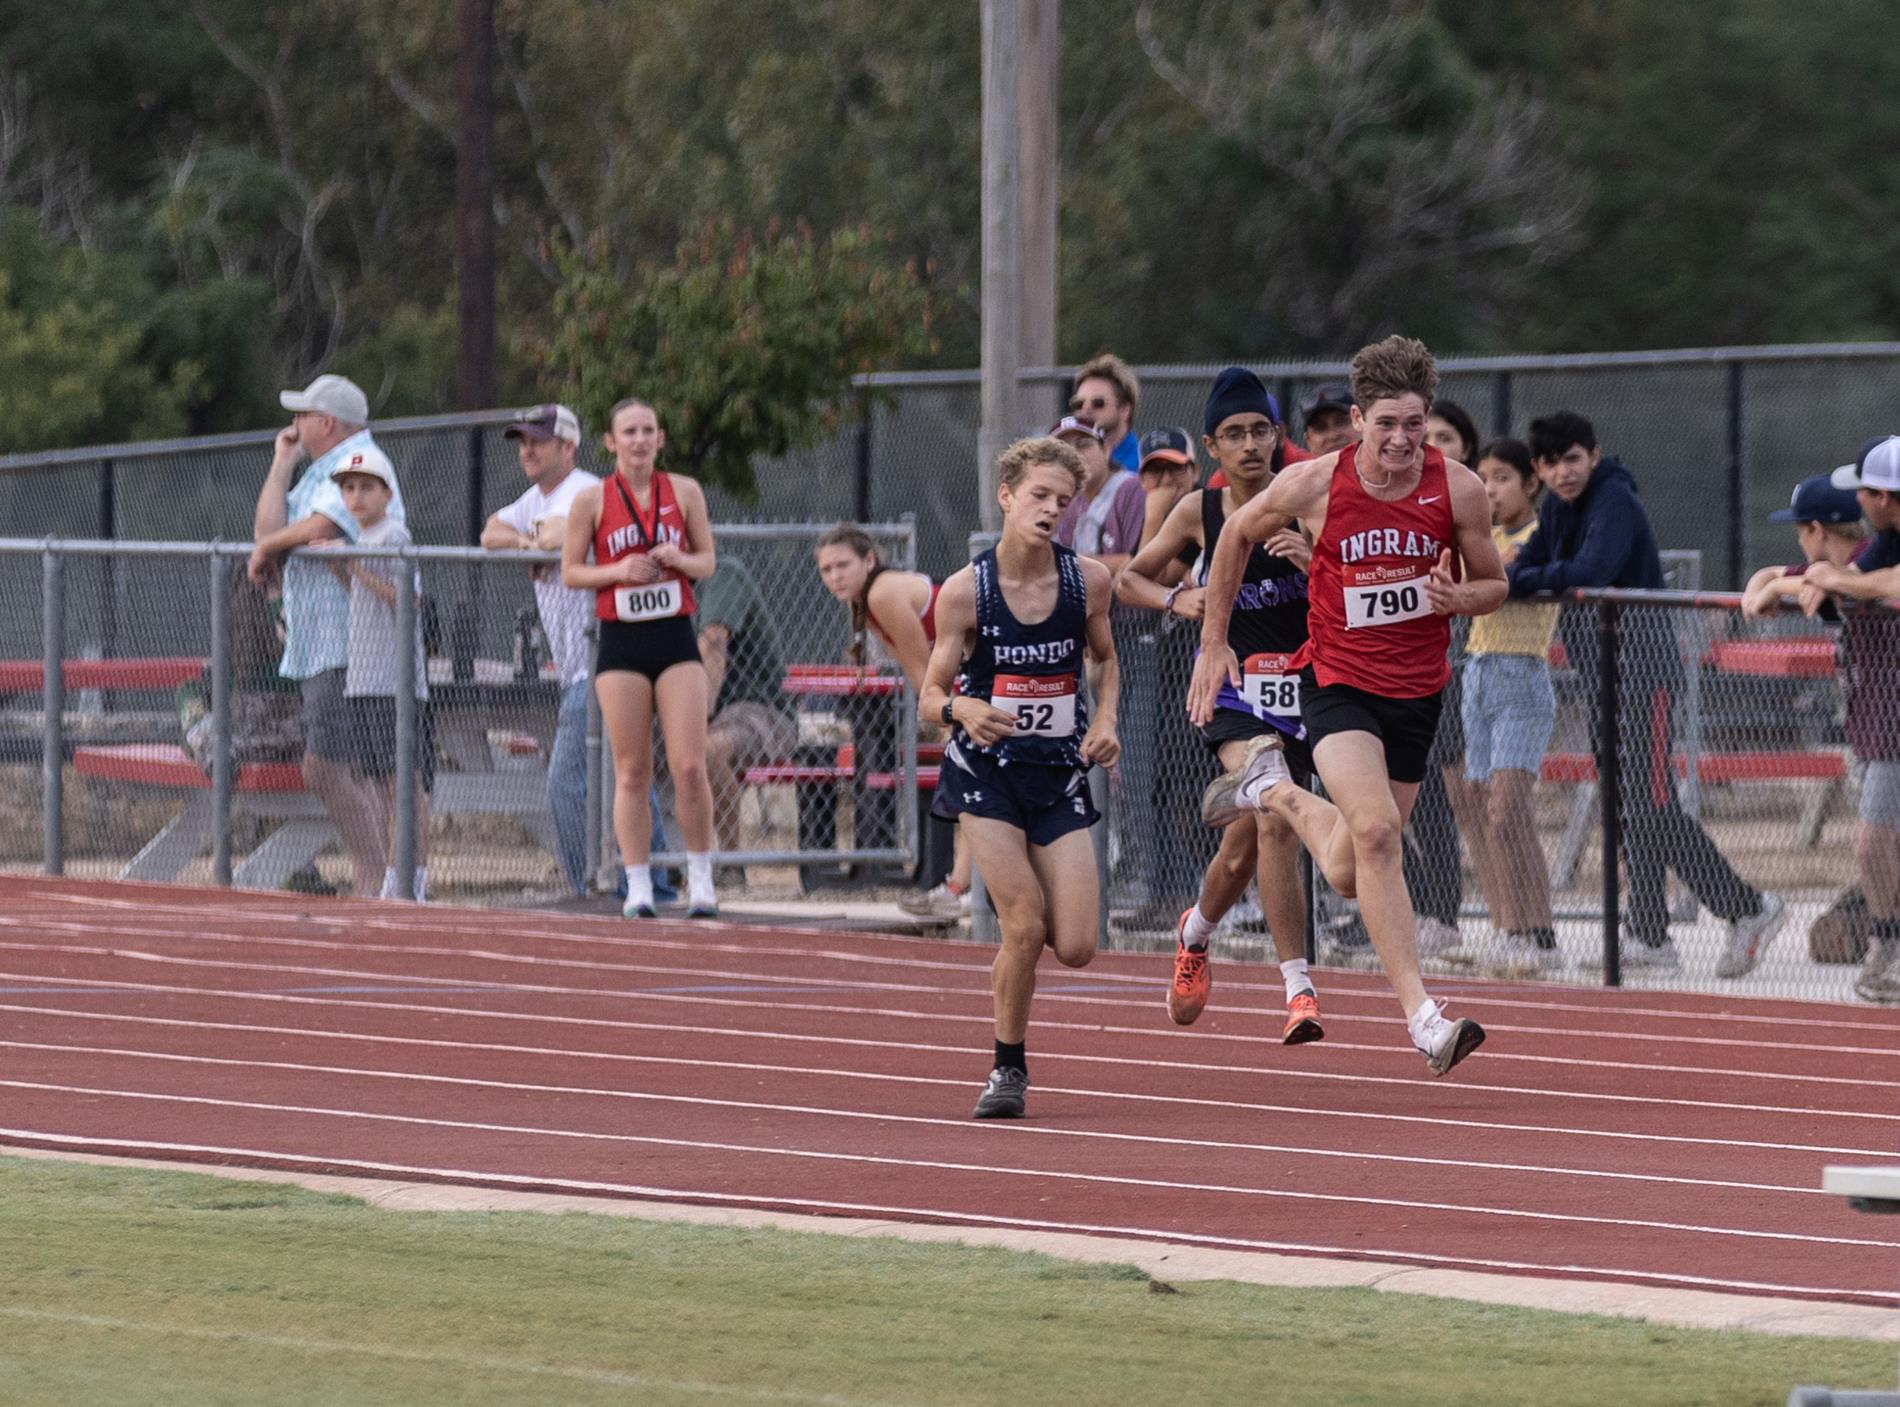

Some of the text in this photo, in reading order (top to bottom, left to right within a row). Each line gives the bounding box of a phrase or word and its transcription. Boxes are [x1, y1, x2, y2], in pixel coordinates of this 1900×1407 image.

[607, 523, 681, 558] INGAM
[1340, 528, 1440, 564] INGRAM
[1355, 572, 1377, 581] RACE
[1387, 565, 1416, 578] RESULT
[629, 589, 671, 613] 800
[1360, 586, 1419, 619] 790
[993, 638, 1074, 666] HONDO
[1258, 660, 1279, 669] RACE
[1006, 681, 1065, 693] RACE RESULT
[1260, 681, 1296, 708] 58
[1015, 703, 1054, 731] 52
